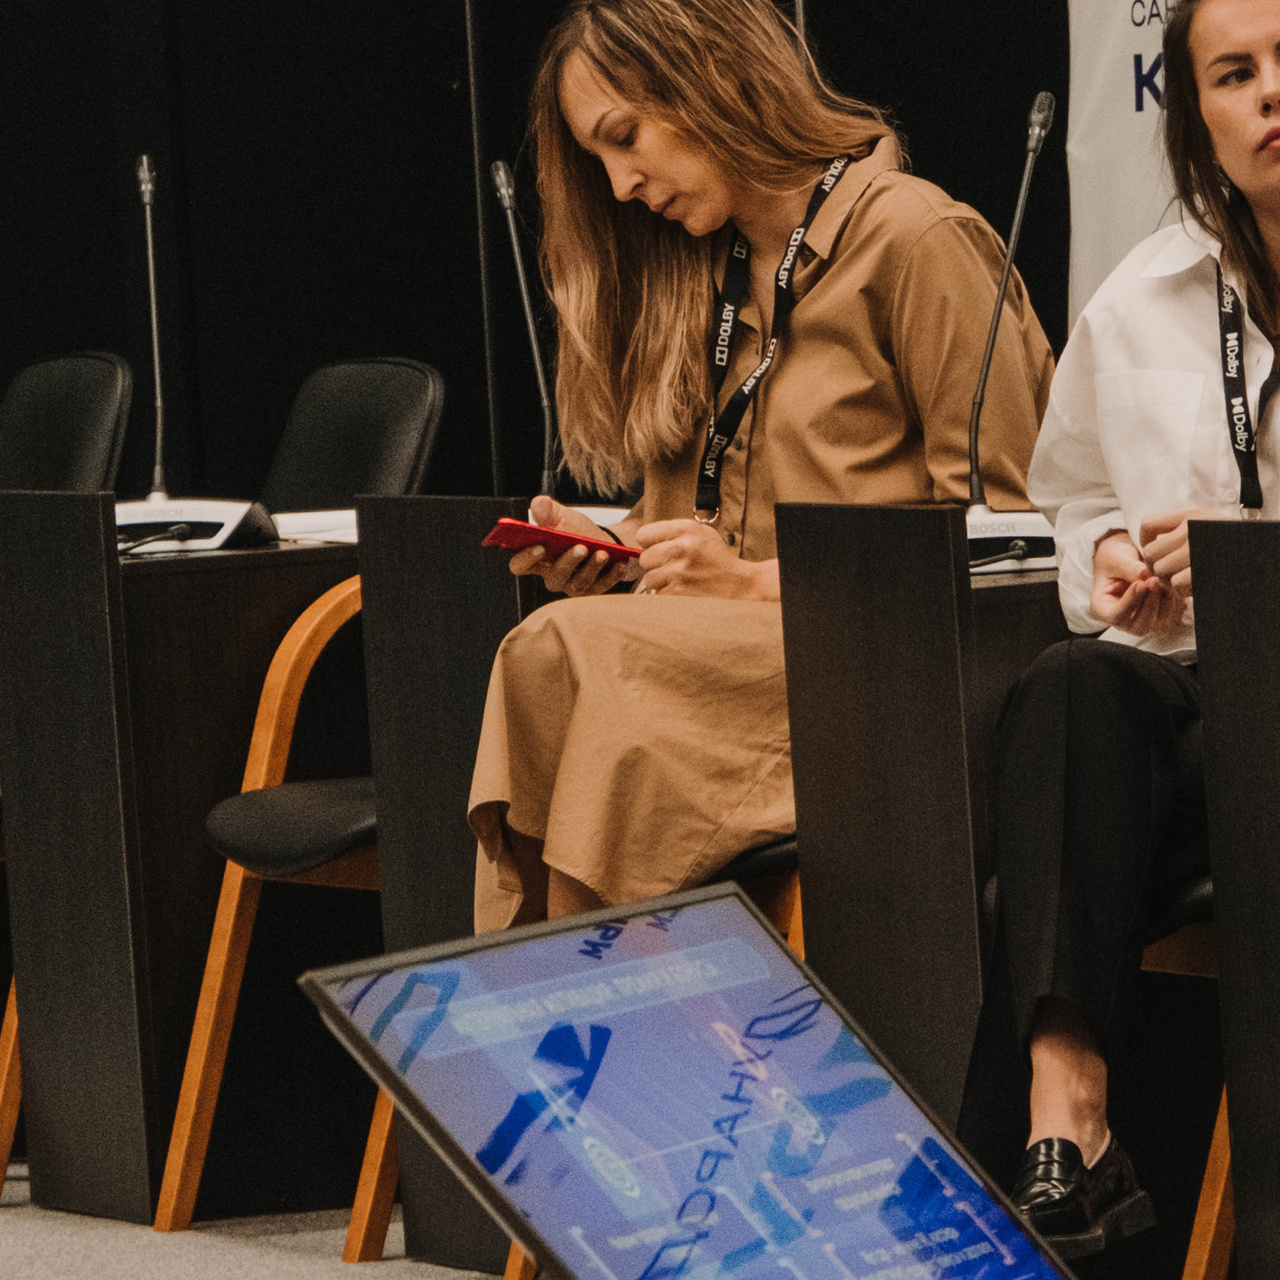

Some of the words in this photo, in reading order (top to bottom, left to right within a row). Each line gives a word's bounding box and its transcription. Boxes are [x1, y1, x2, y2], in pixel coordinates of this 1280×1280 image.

[777, 245, 797, 289] DOLBY
[717, 302, 735, 346] DOLBY
[1226, 346, 1239, 378] Dolby
[1232, 416, 1248, 452] Dolby
[969, 523, 1016, 534] BOSCH
